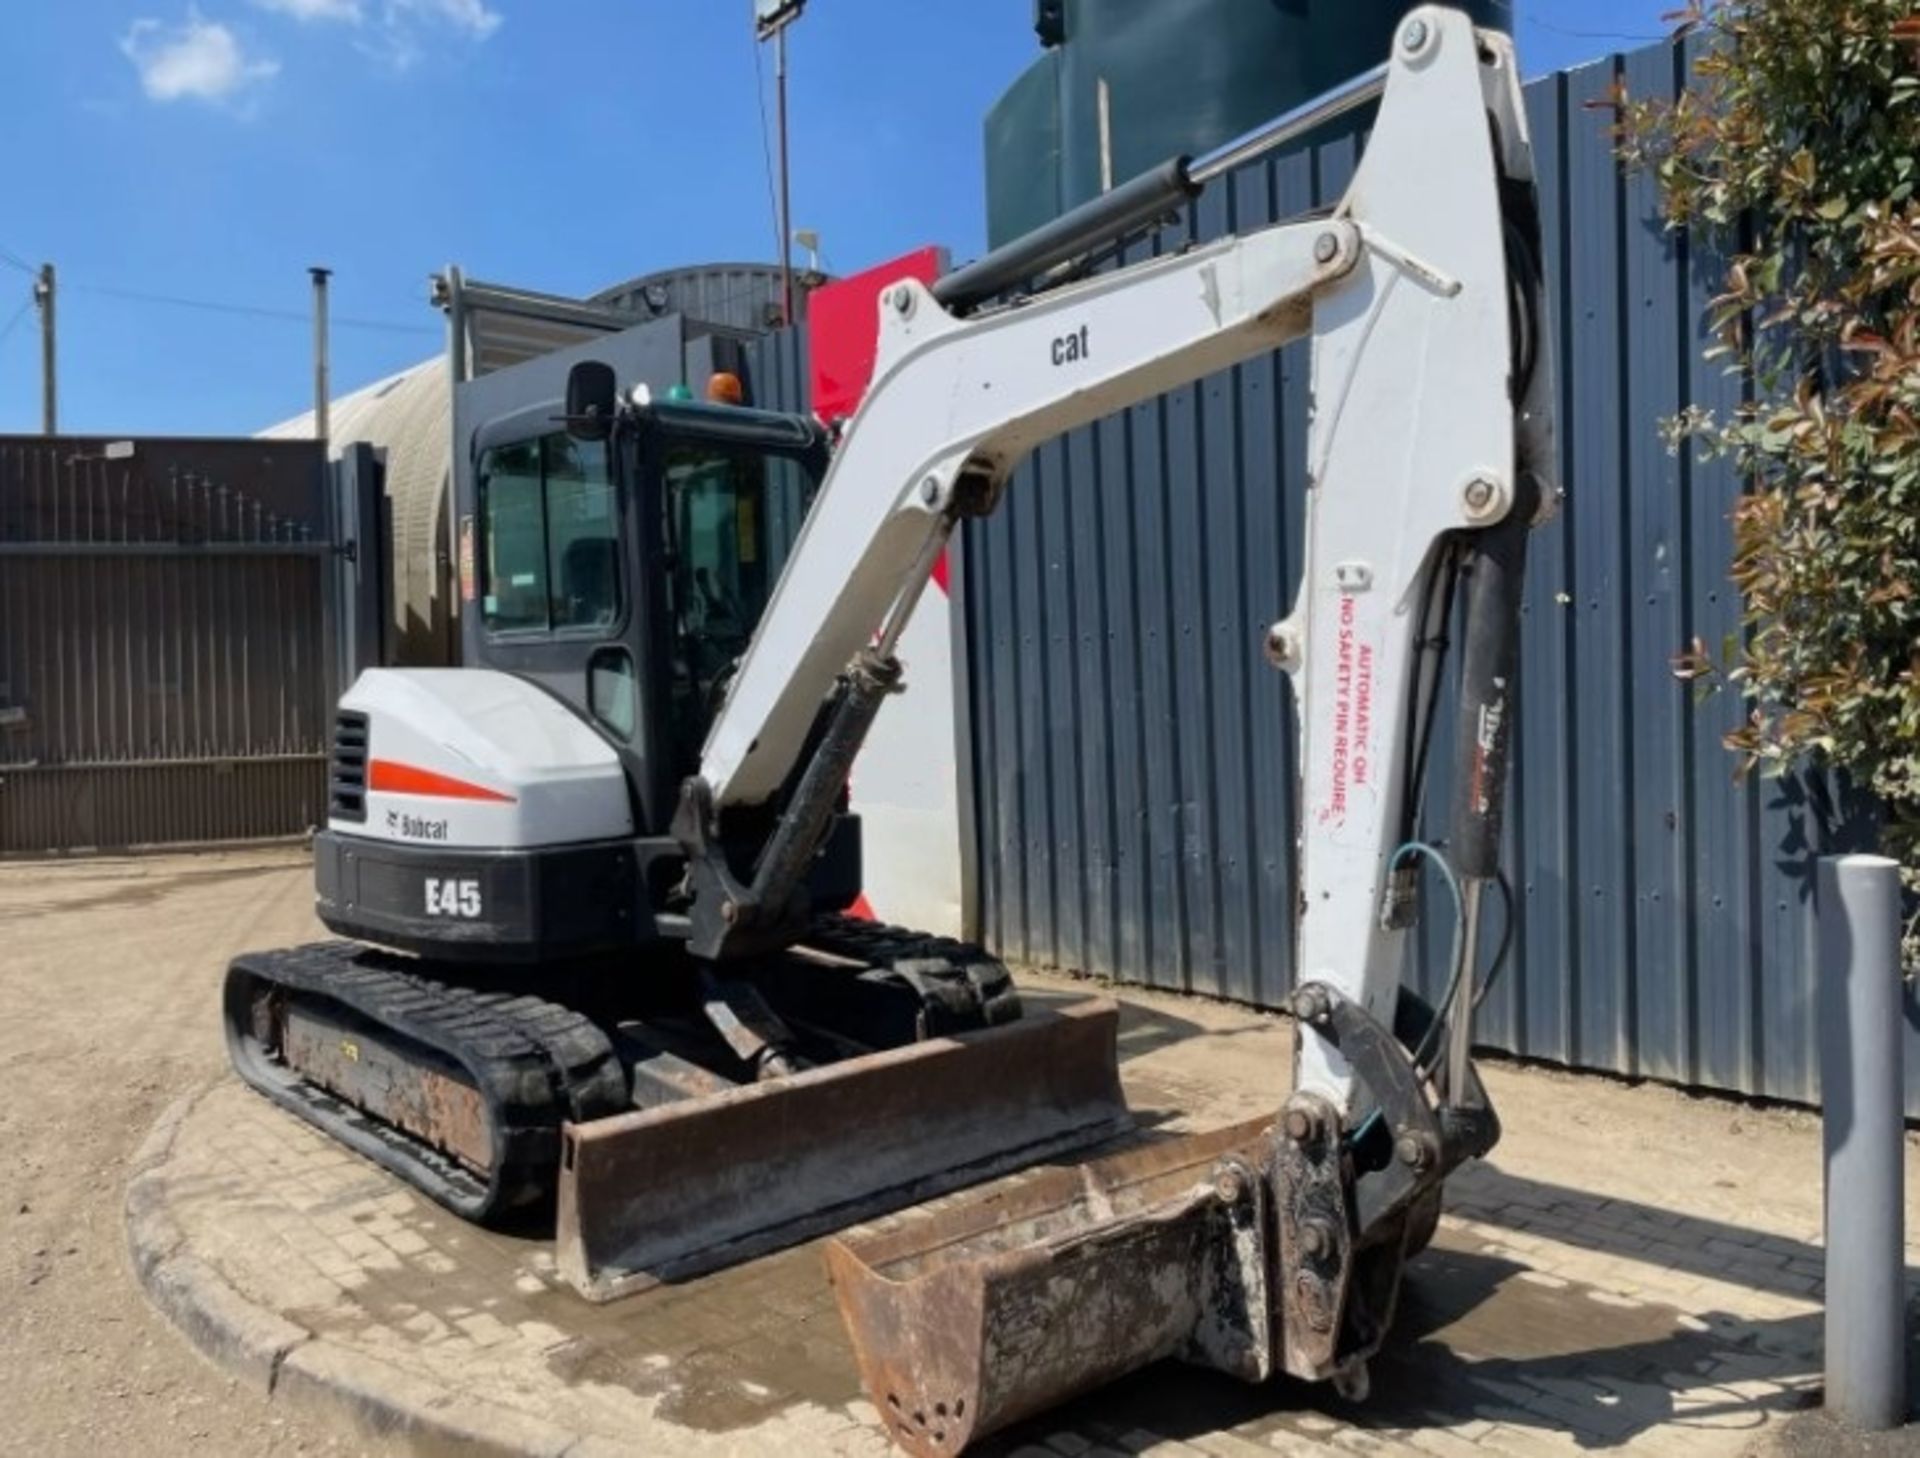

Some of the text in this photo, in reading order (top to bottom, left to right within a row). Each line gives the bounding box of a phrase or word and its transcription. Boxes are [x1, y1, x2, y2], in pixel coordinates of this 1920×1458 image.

[1052, 325, 1088, 366] cat
[1331, 598, 1354, 826] NO SAFETY PIN REQUIRE
[1355, 644, 1371, 750] AUTOMATIC
[402, 814, 448, 840] Bobcat
[424, 878, 482, 918] E45
